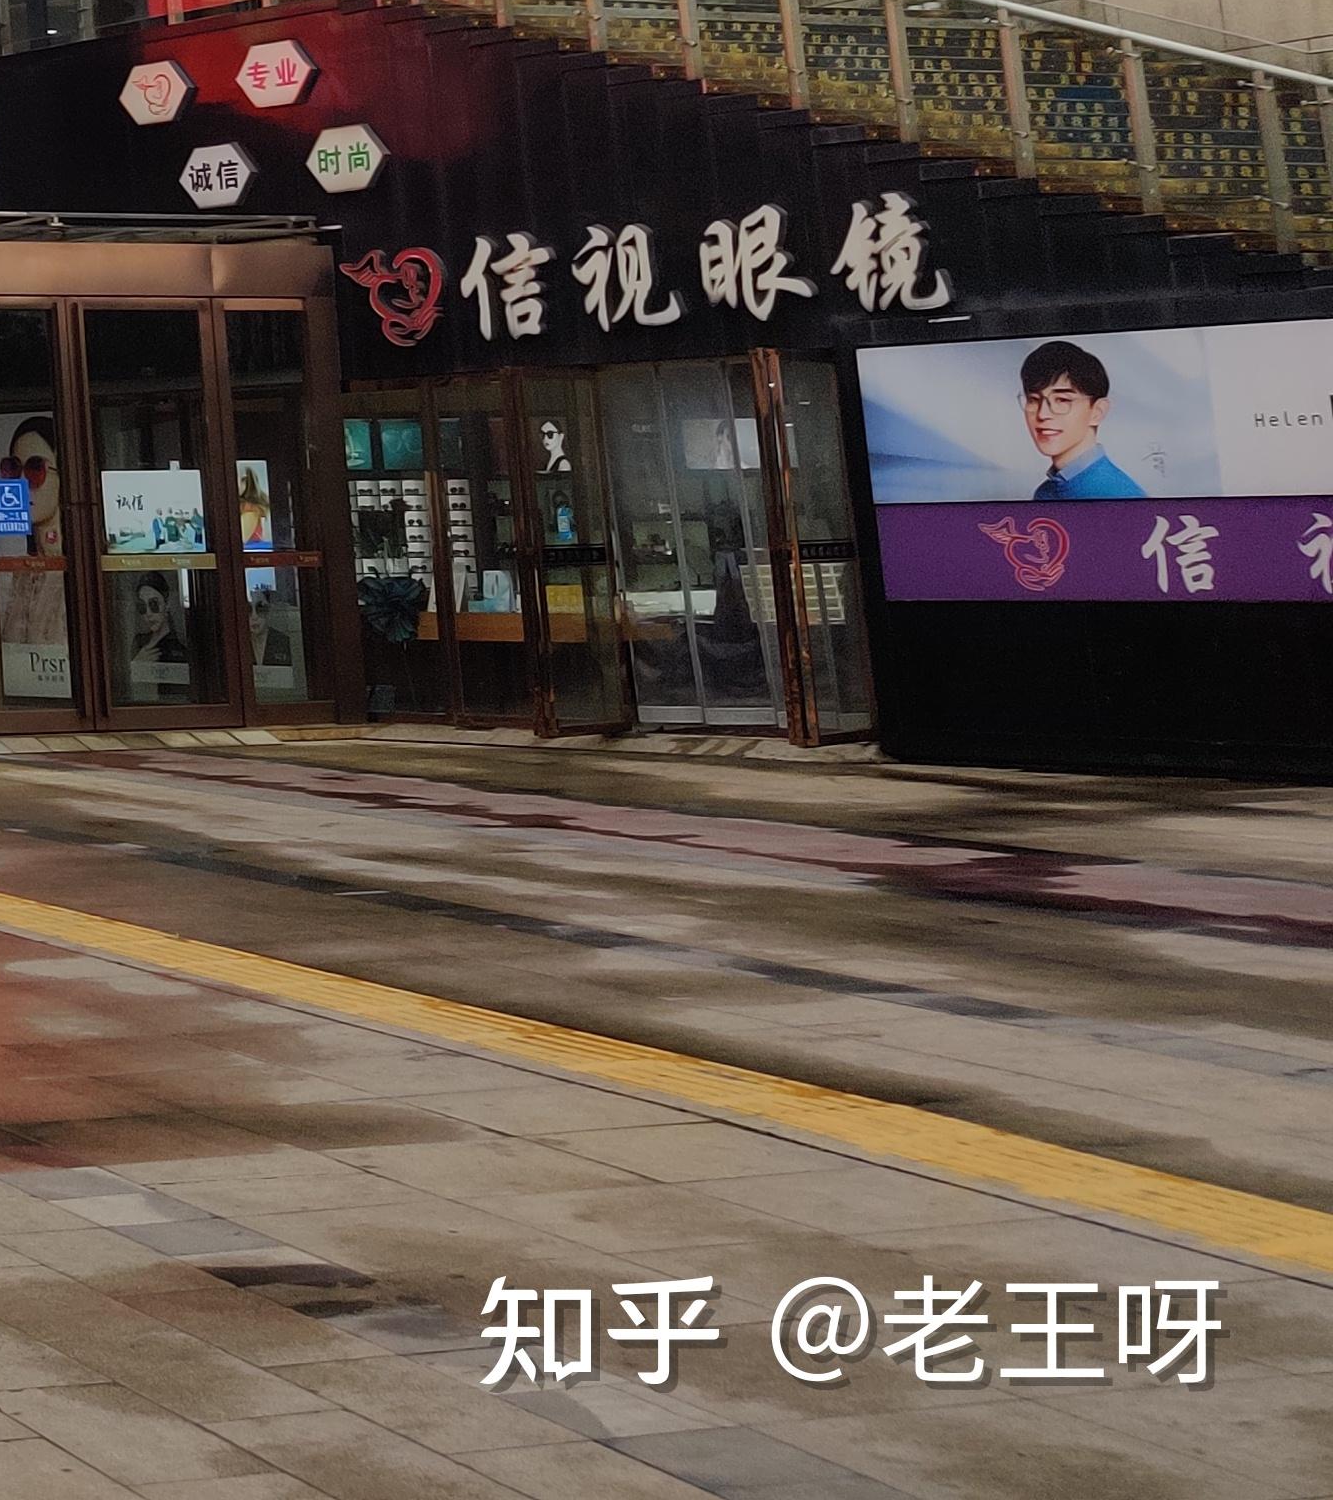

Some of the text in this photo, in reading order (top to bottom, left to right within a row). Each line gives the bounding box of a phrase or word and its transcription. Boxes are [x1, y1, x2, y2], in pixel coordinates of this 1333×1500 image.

[246, 57, 299, 90] 专业
[317, 142, 372, 177] 时尚
[188, 161, 241, 193] 诚信
[461, 191, 953, 342] 信视眼镜
[1254, 412, 1324, 429] Helen
